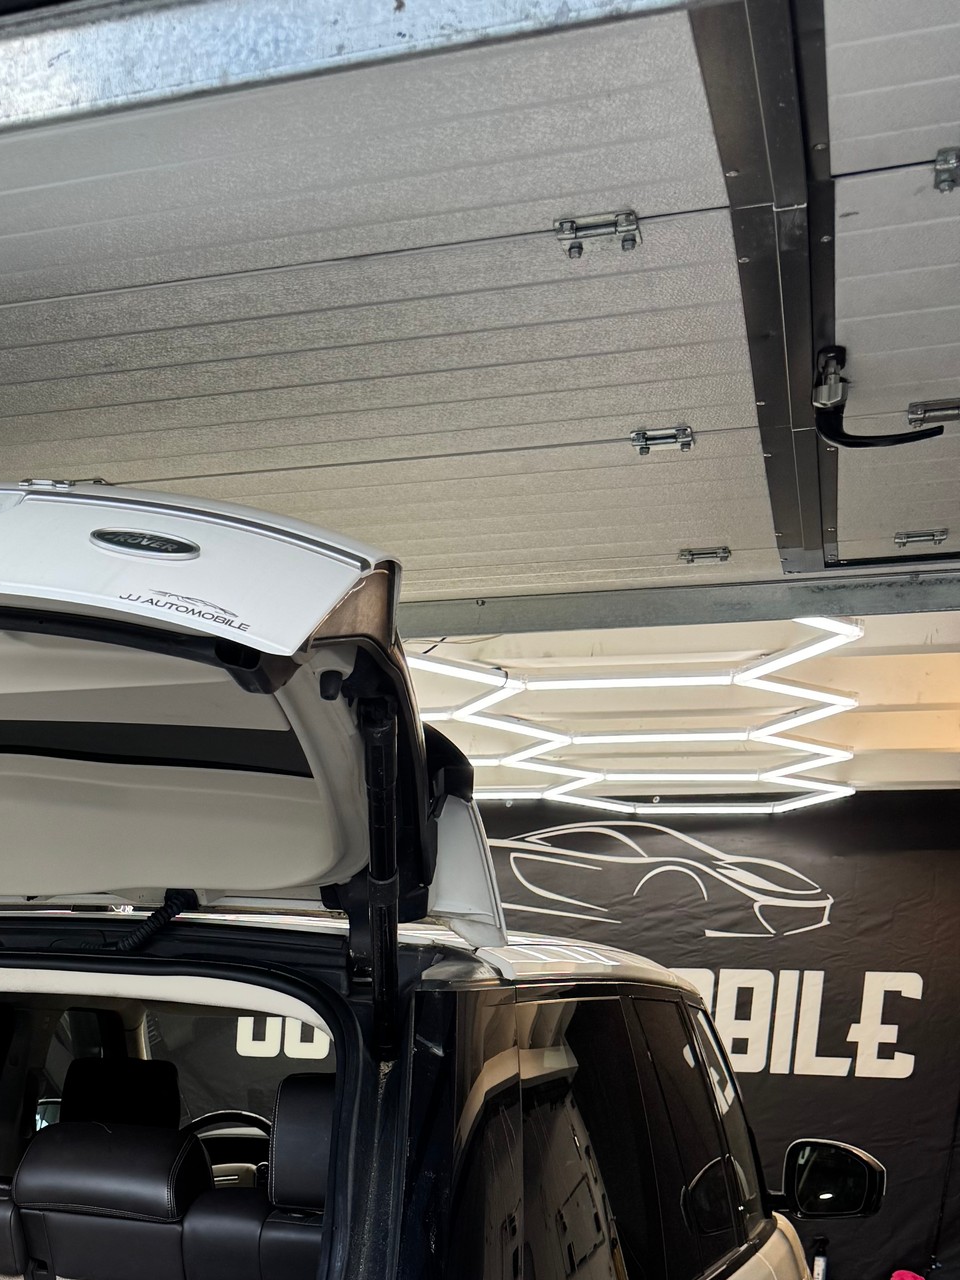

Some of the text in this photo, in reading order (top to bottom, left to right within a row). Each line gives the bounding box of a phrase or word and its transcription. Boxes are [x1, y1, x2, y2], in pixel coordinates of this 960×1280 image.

[113, 534, 178, 552] ROVER
[119, 593, 251, 632] JJ AUTOMOBILE
